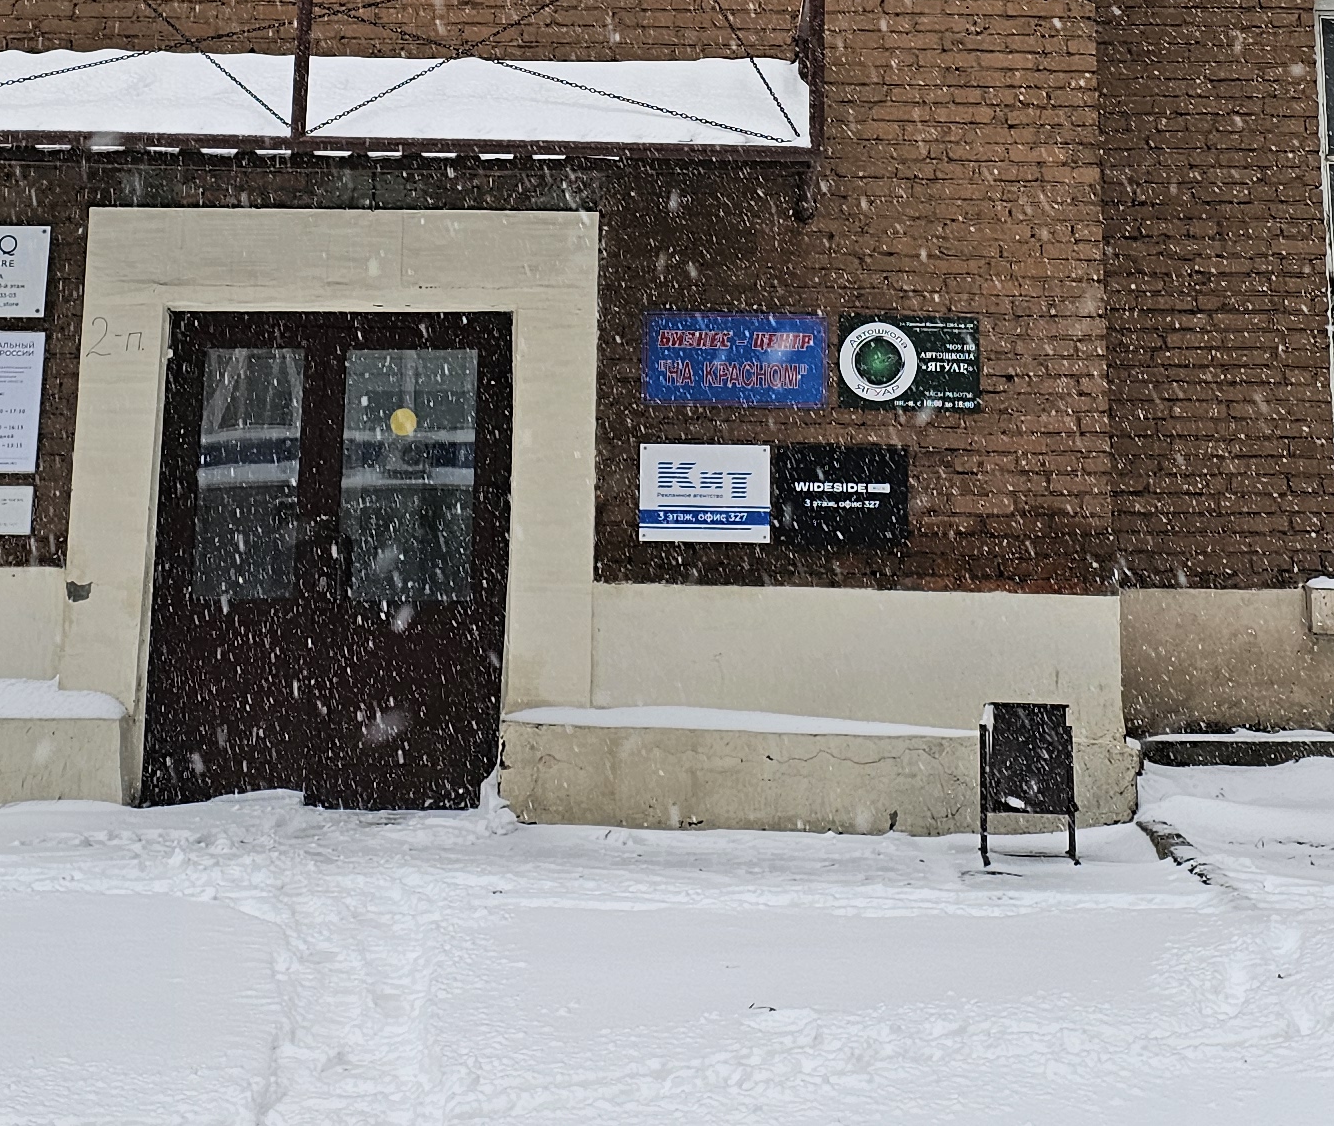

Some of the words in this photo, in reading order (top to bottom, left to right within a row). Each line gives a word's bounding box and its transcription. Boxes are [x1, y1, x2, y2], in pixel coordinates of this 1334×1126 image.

[658, 330, 732, 349] БИЗНЕС
[752, 332, 814, 351] ЦЕНТР
[0, 349, 35, 357] РОССИИ
[919, 352, 975, 360] АВТОШКОЛА
[855, 384, 899, 397] ЯГУАР
[794, 481, 867, 493] WIDESIDE
[804, 499, 811, 507] 3
[838, 500, 863, 509] офис
[863, 500, 880, 508] 327
[657, 512, 664, 521] 3
[666, 513, 696, 522] этаж,
[697, 512, 727, 523] офис
[728, 512, 748, 522] 327
